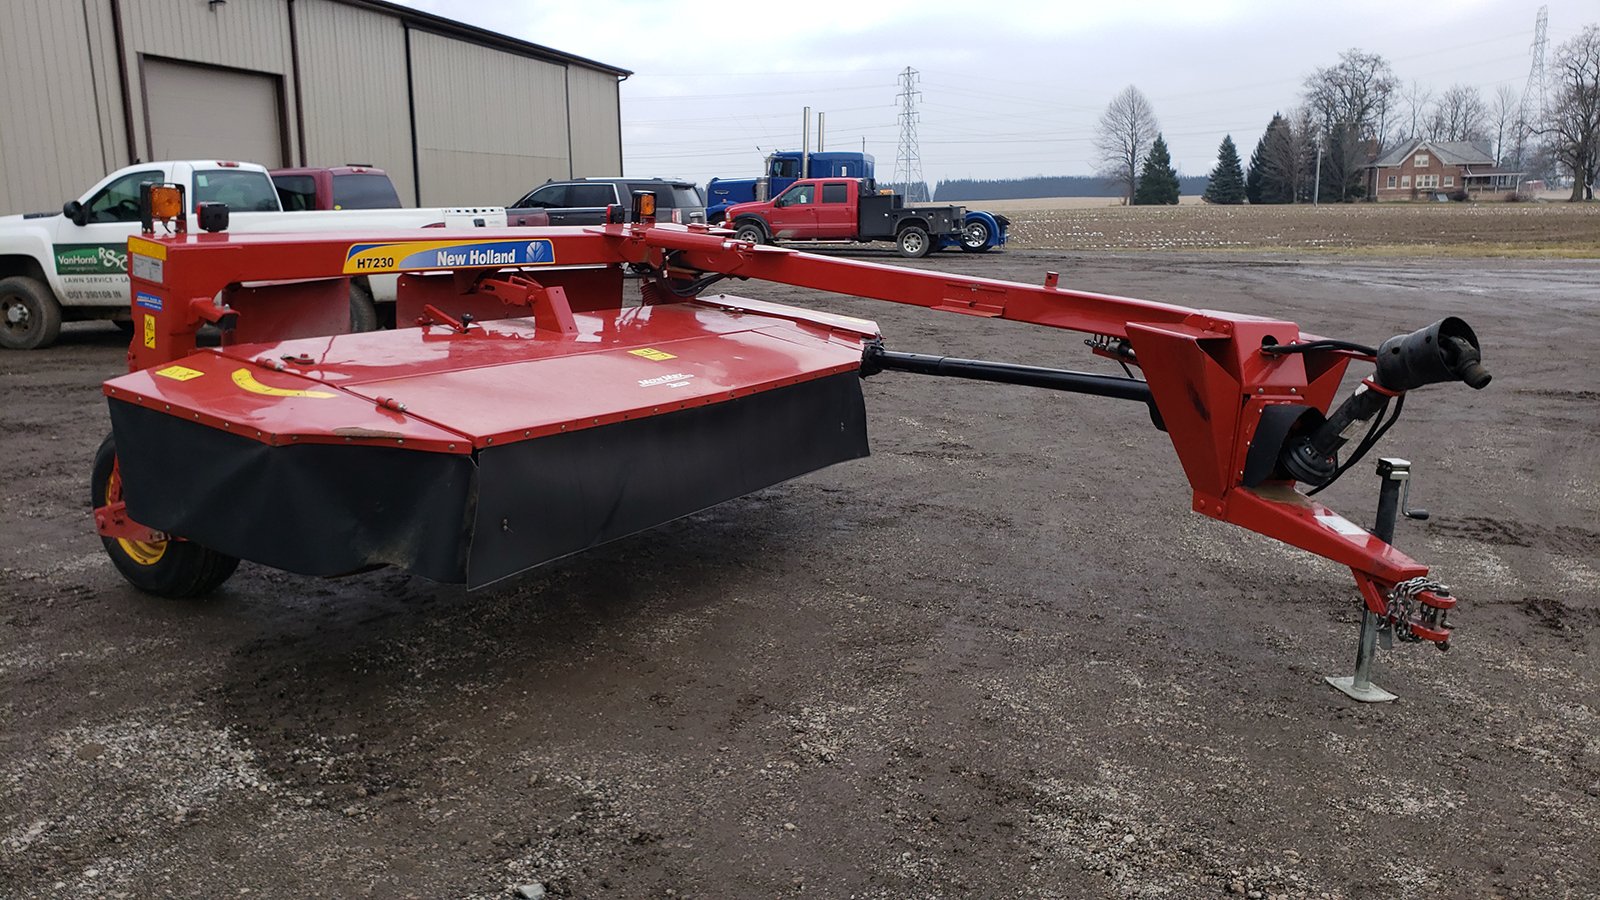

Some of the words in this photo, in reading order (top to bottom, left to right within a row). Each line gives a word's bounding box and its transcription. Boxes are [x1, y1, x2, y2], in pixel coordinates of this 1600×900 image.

[58, 255, 97, 265] VanHorn's
[357, 257, 394, 269] H7230
[437, 250, 466, 266] New
[469, 249, 516, 265] Holland
[64, 276, 84, 284] LAWN
